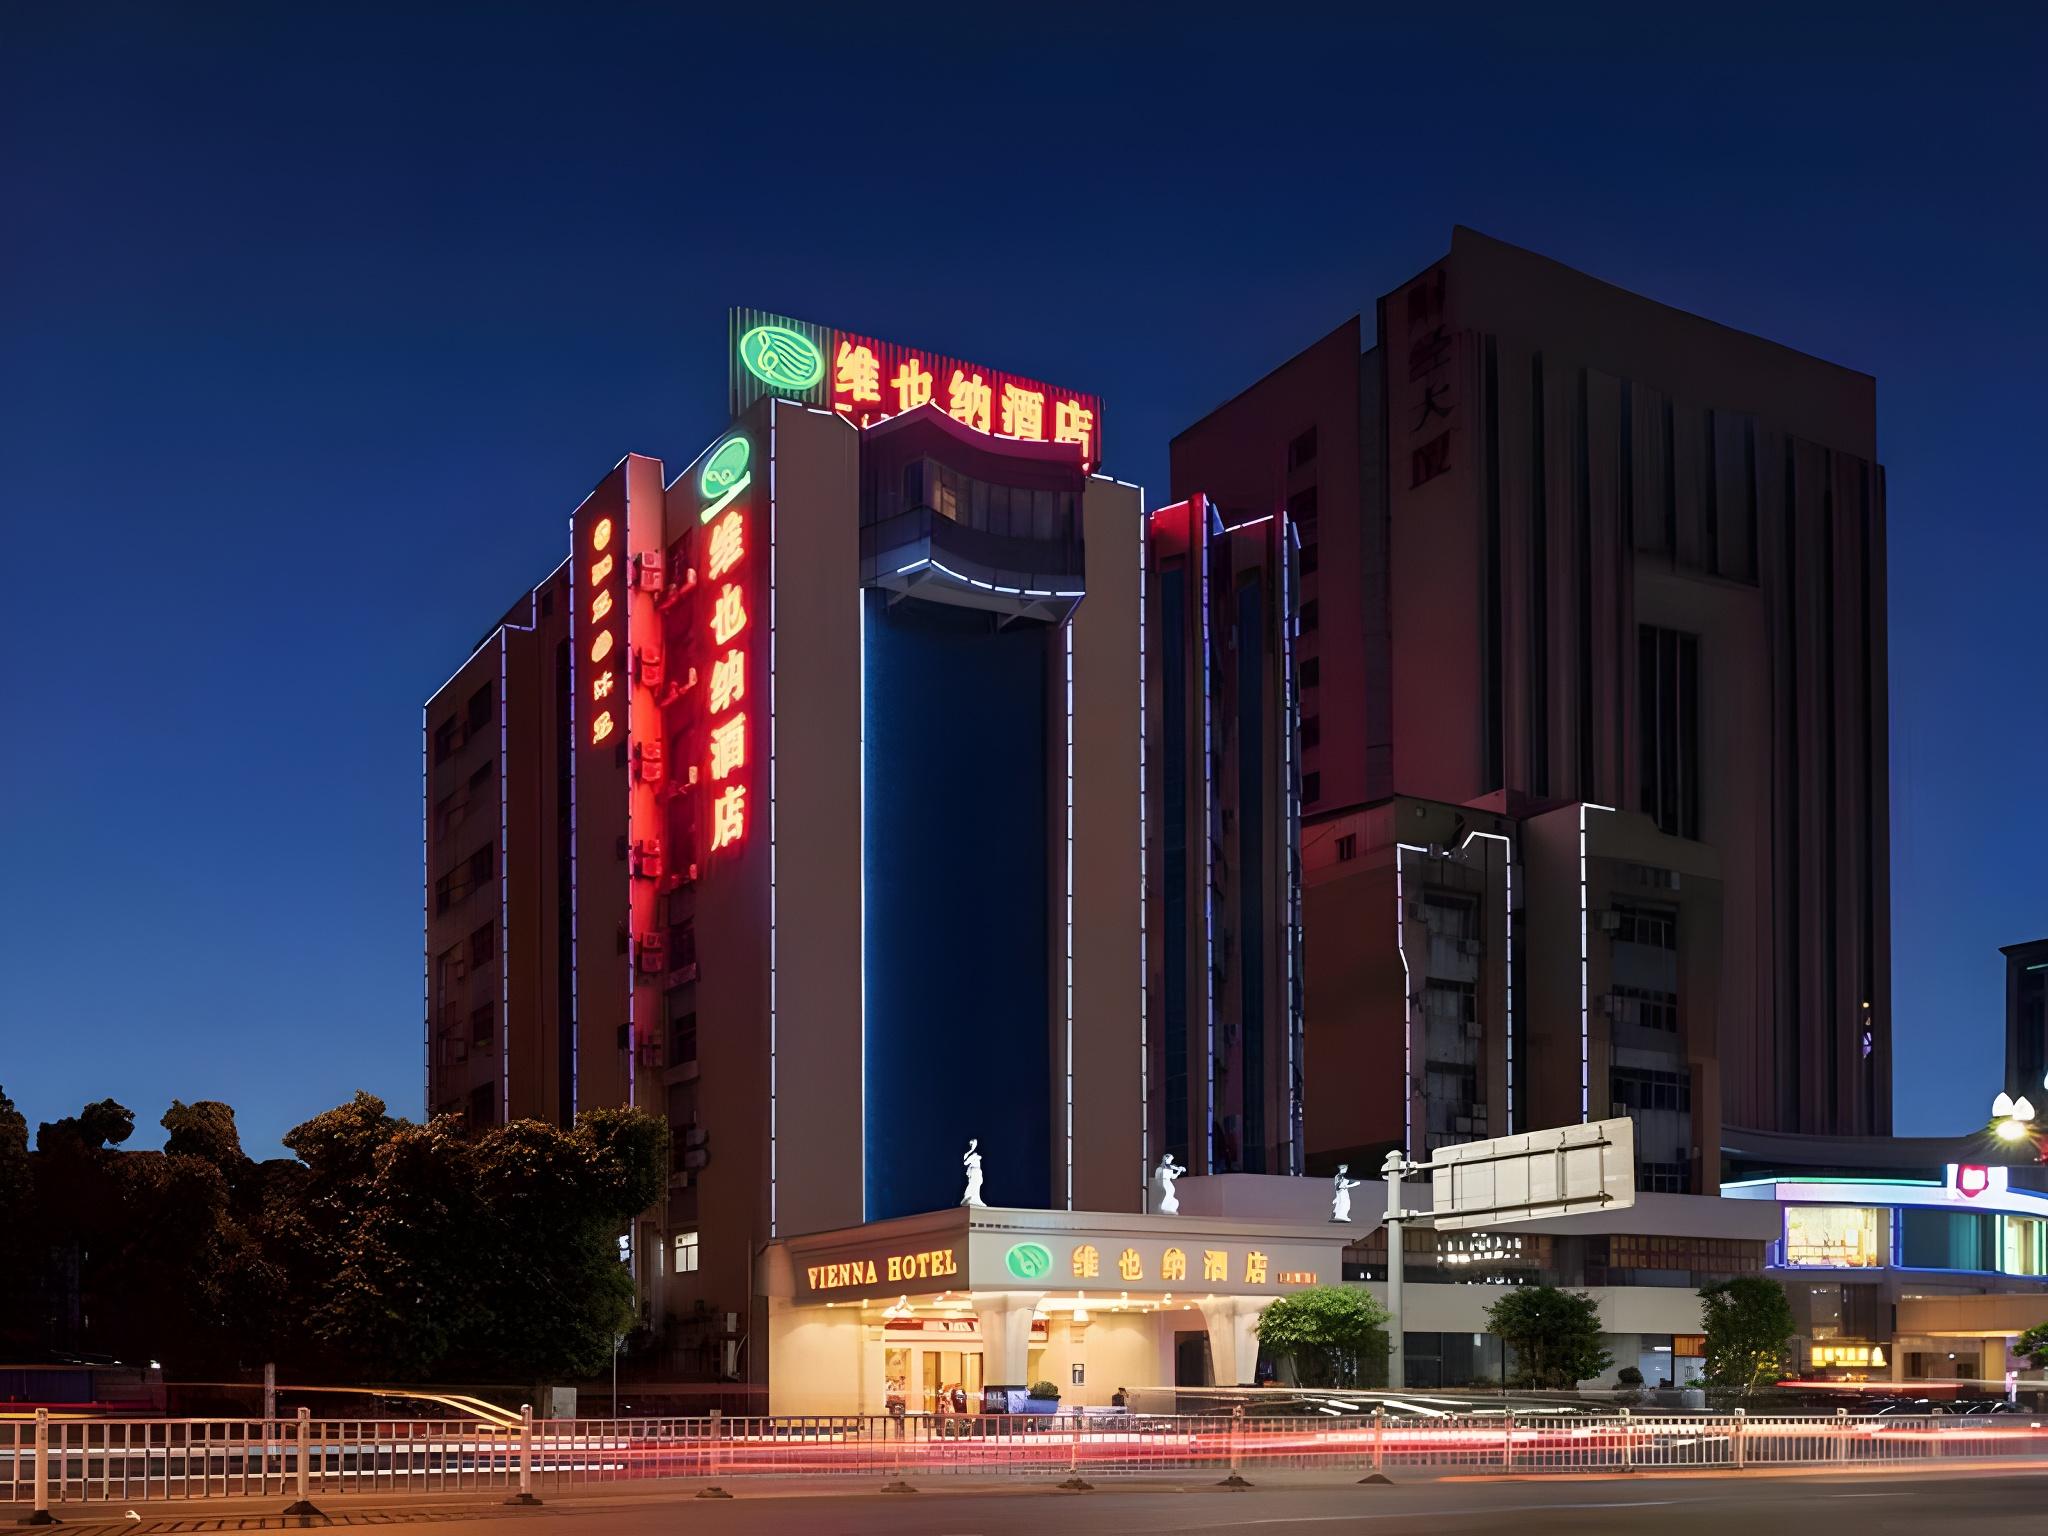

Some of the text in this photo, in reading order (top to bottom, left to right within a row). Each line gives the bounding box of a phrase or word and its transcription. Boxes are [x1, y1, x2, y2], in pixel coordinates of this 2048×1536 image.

[835, 340, 1093, 448] 维也纳酒店
[709, 511, 747, 851] 维也纳酒店
[808, 1249, 957, 1290] VIENNA HOTEL
[1072, 1245, 1267, 1284] 维也纳酒店
